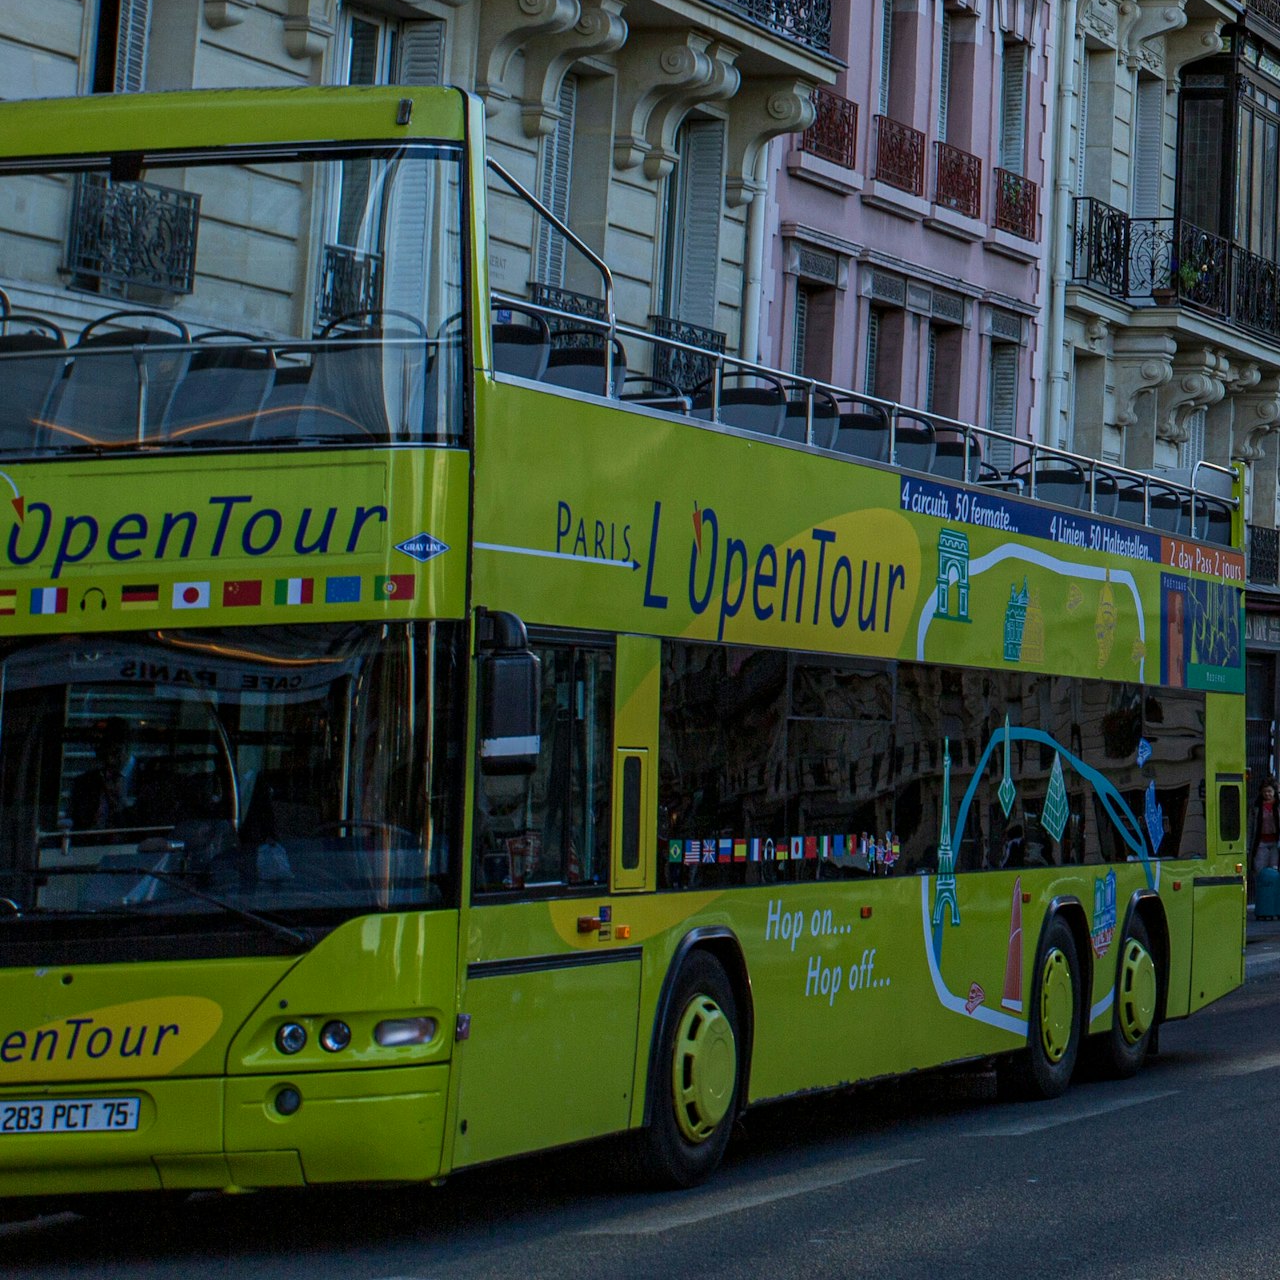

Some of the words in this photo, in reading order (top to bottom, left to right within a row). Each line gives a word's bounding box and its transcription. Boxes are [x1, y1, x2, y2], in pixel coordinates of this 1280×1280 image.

[902, 480, 910, 510] 4
[954, 492, 970, 523] 50
[7, 496, 388, 579] OpenTour
[403, 543, 425, 552] GRAY
[1049, 515, 1057, 542] 4
[1058, 516, 1088, 552] Linien,
[1089, 524, 1102, 551] 50
[1170, 541, 1177, 567] 2
[1178, 543, 1194, 578] day
[1196, 547, 1213, 574] Pass
[1214, 551, 1220, 577] 2
[1221, 557, 1242, 585] jours
[765, 899, 804, 953] Hop
[810, 908, 852, 937] on...
[805, 955, 842, 1007] Hop
[848, 948, 891, 992] off...
[2, 1105, 44, 1131] 283
[52, 1104, 93, 1129] PCT
[103, 1102, 130, 1126] 75
